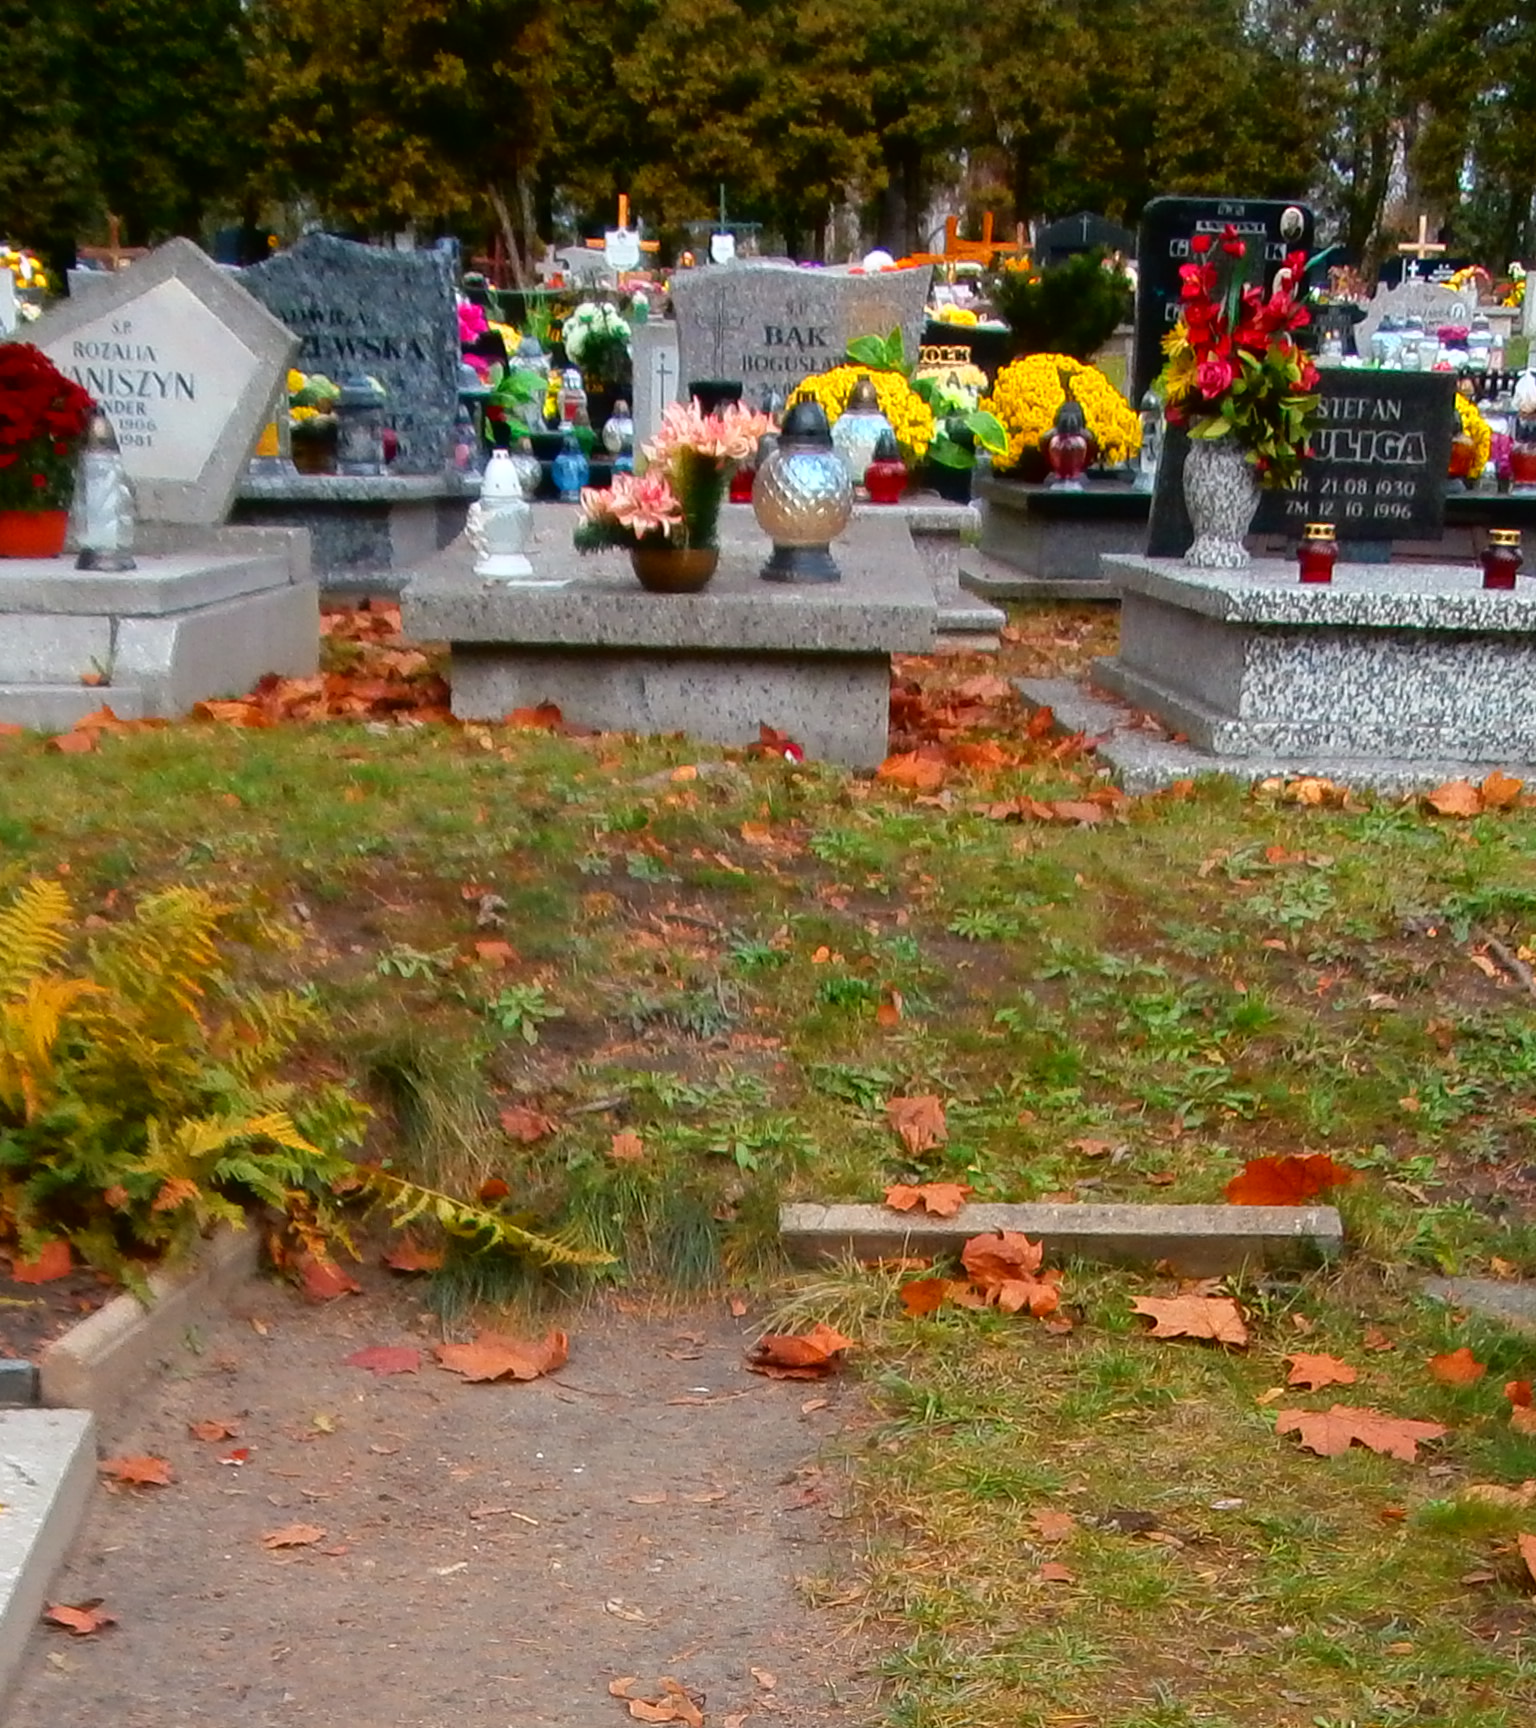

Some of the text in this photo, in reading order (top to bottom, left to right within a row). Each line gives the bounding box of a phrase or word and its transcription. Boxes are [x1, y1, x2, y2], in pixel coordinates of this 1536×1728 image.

[72, 340, 158, 363] ROZALIA
[764, 325, 828, 353] BĄK
[64, 365, 197, 402] ANISZYN
[1317, 396, 1402, 421] STEFAN
[1307, 428, 1428, 465] ULIGA
